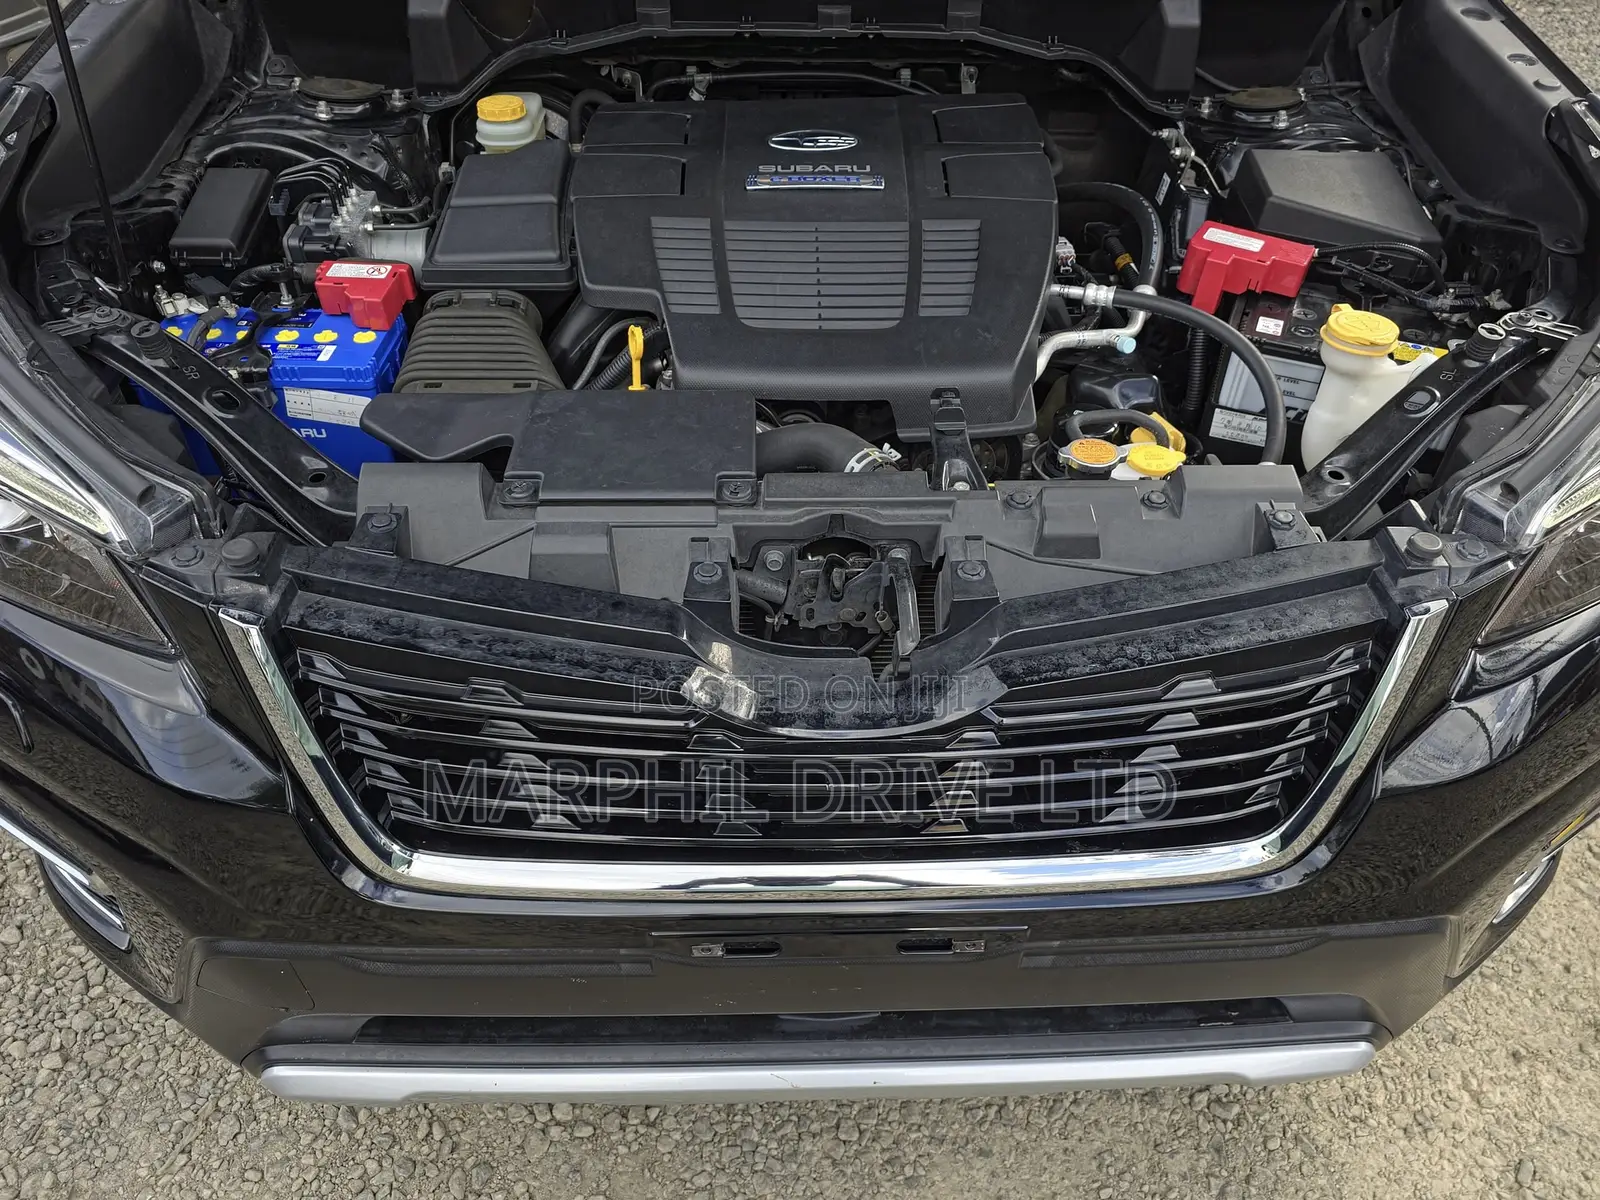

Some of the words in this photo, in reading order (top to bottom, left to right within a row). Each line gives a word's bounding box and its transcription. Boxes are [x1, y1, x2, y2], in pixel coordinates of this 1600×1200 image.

[758, 164, 871, 173] SUBARU
[182, 365, 200, 380] SR
[1439, 369, 1457, 381] SL
